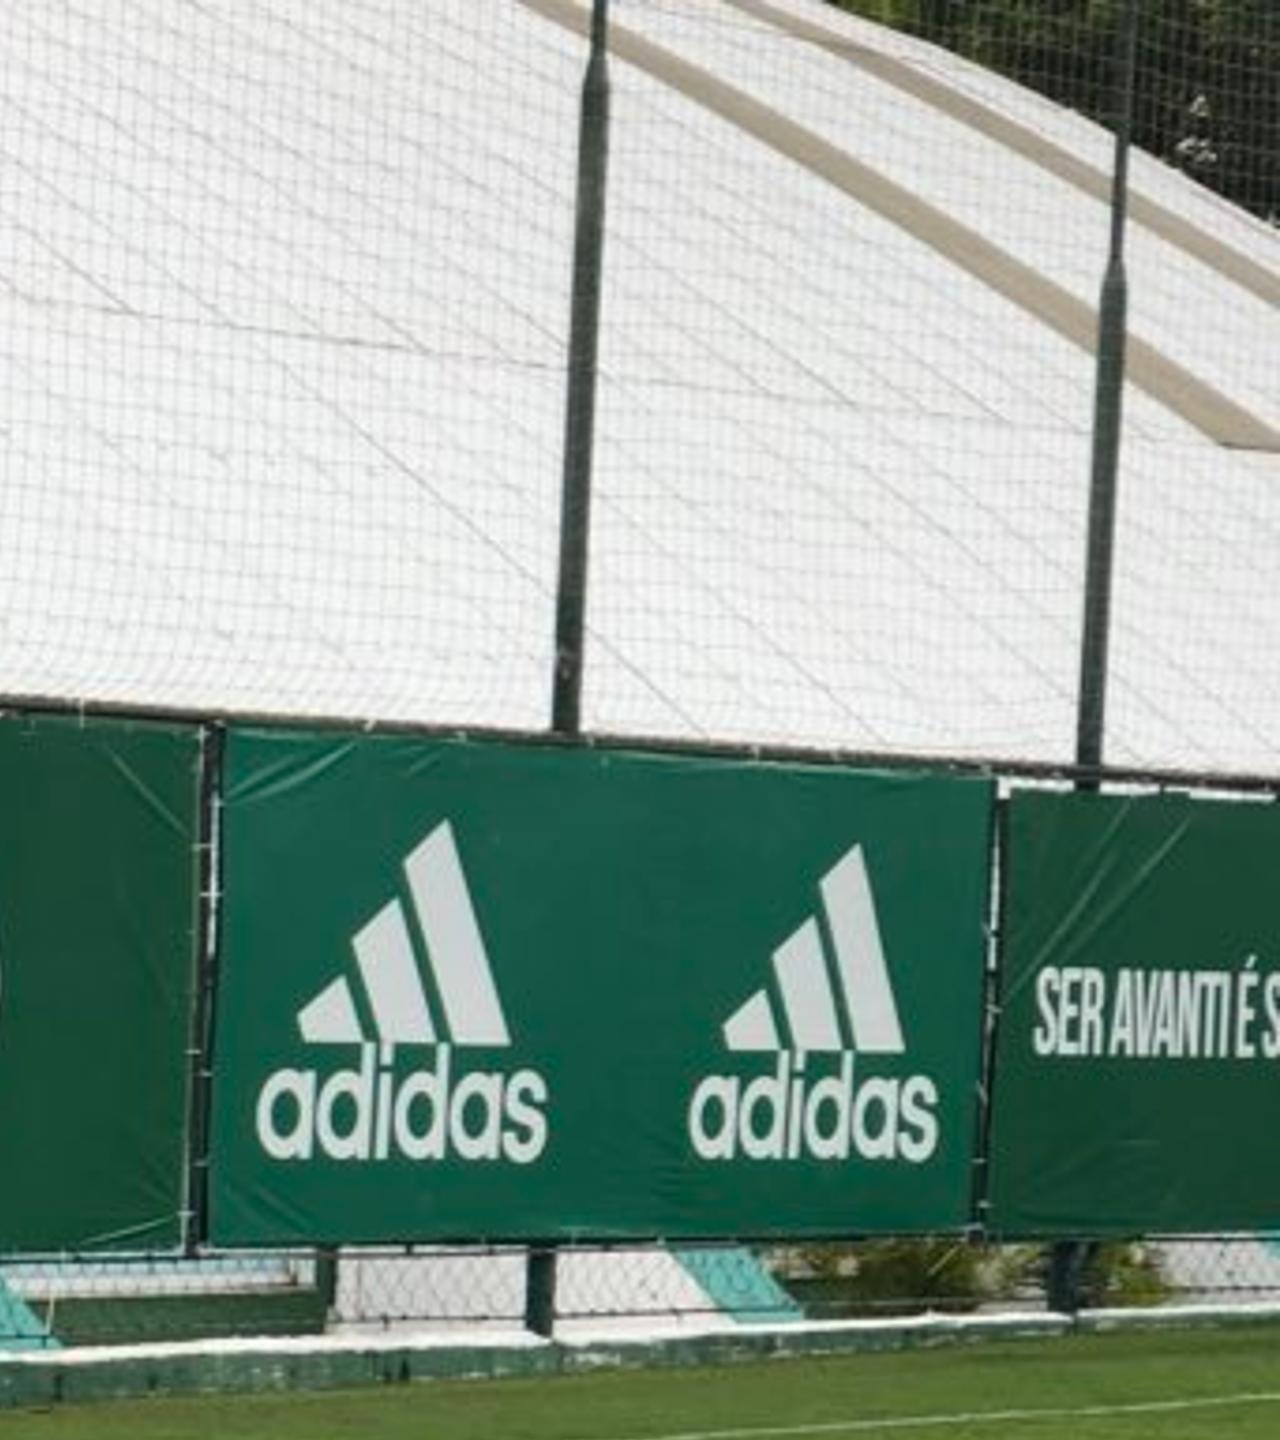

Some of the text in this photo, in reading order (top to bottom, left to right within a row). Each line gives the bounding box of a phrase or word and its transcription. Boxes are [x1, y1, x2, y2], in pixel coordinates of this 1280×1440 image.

[1034, 966, 1105, 1056] SER
[1107, 968, 1232, 1058] AVANTI
[1235, 954, 1260, 1059] É
[256, 1041, 548, 1165] adidas
[688, 1050, 939, 1164] adidas
